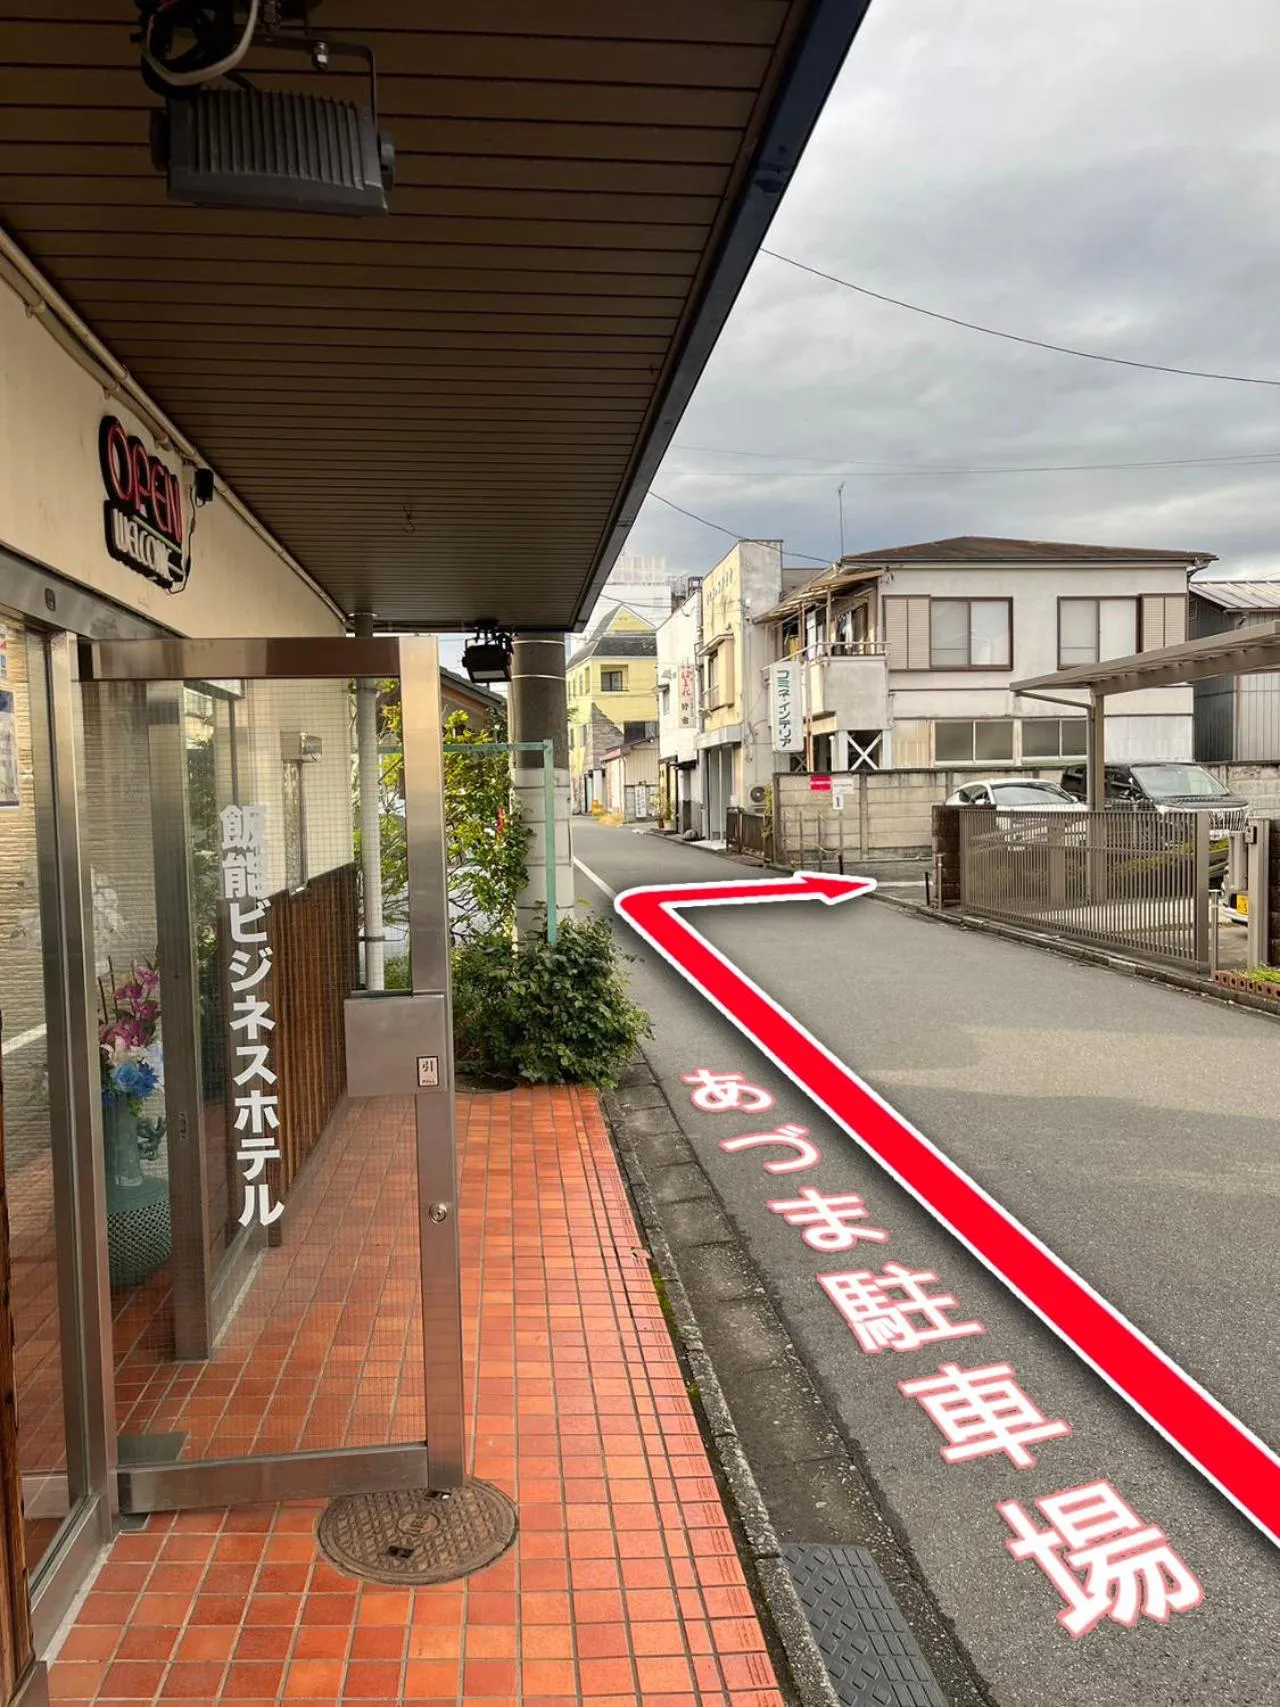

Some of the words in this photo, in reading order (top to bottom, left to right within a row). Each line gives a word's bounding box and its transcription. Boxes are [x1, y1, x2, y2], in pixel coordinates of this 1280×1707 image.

[106, 422, 183, 545] OPEN
[112, 506, 185, 582] WELCOME
[219, 803, 285, 1228] 飯能ビジネスホテル
[422, 1059, 434, 1073] 引
